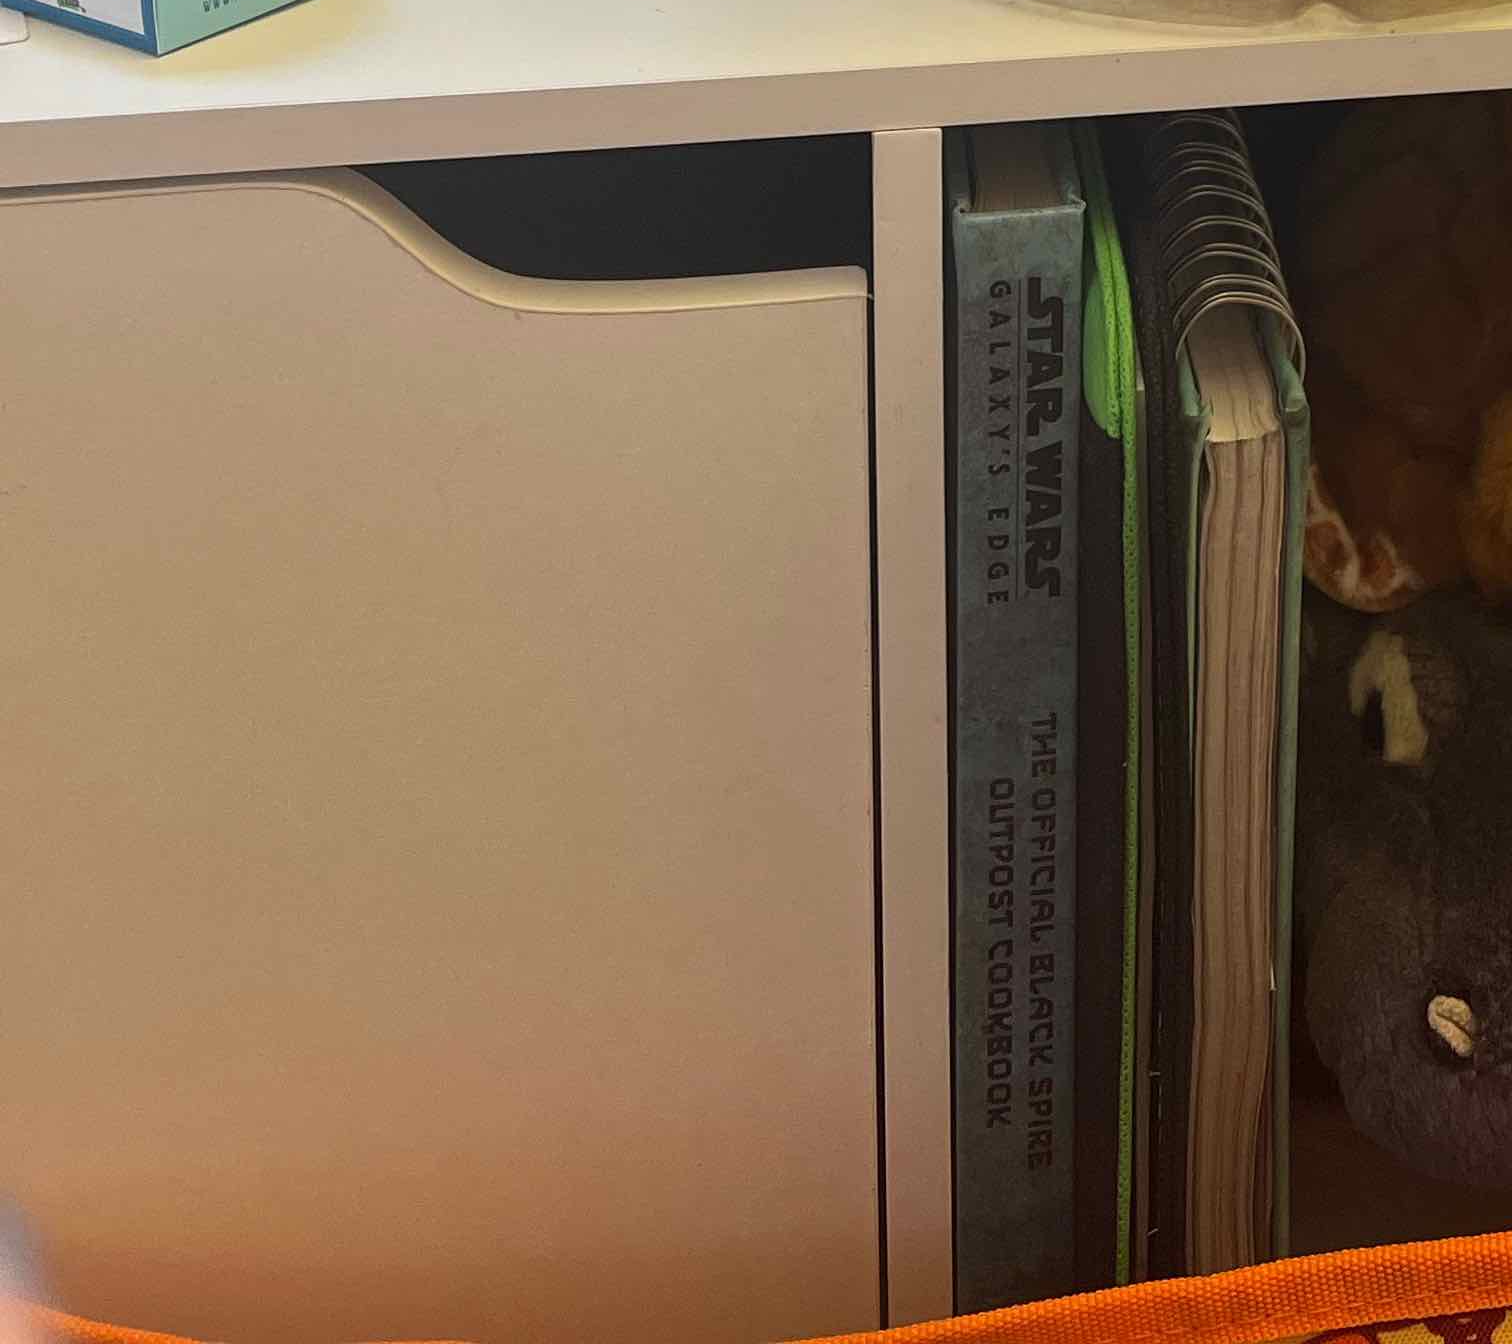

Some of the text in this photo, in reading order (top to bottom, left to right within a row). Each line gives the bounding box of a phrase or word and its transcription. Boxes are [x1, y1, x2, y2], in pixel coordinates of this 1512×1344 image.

[986, 280, 1012, 606] GALAXY'S EDGE
[1023, 276, 1065, 599] STAR WARS
[984, 777, 1015, 1130] OUTPOST COOKBOOK
[1027, 713, 1057, 1170] THE OFFICIAL BLACK SPIRE
